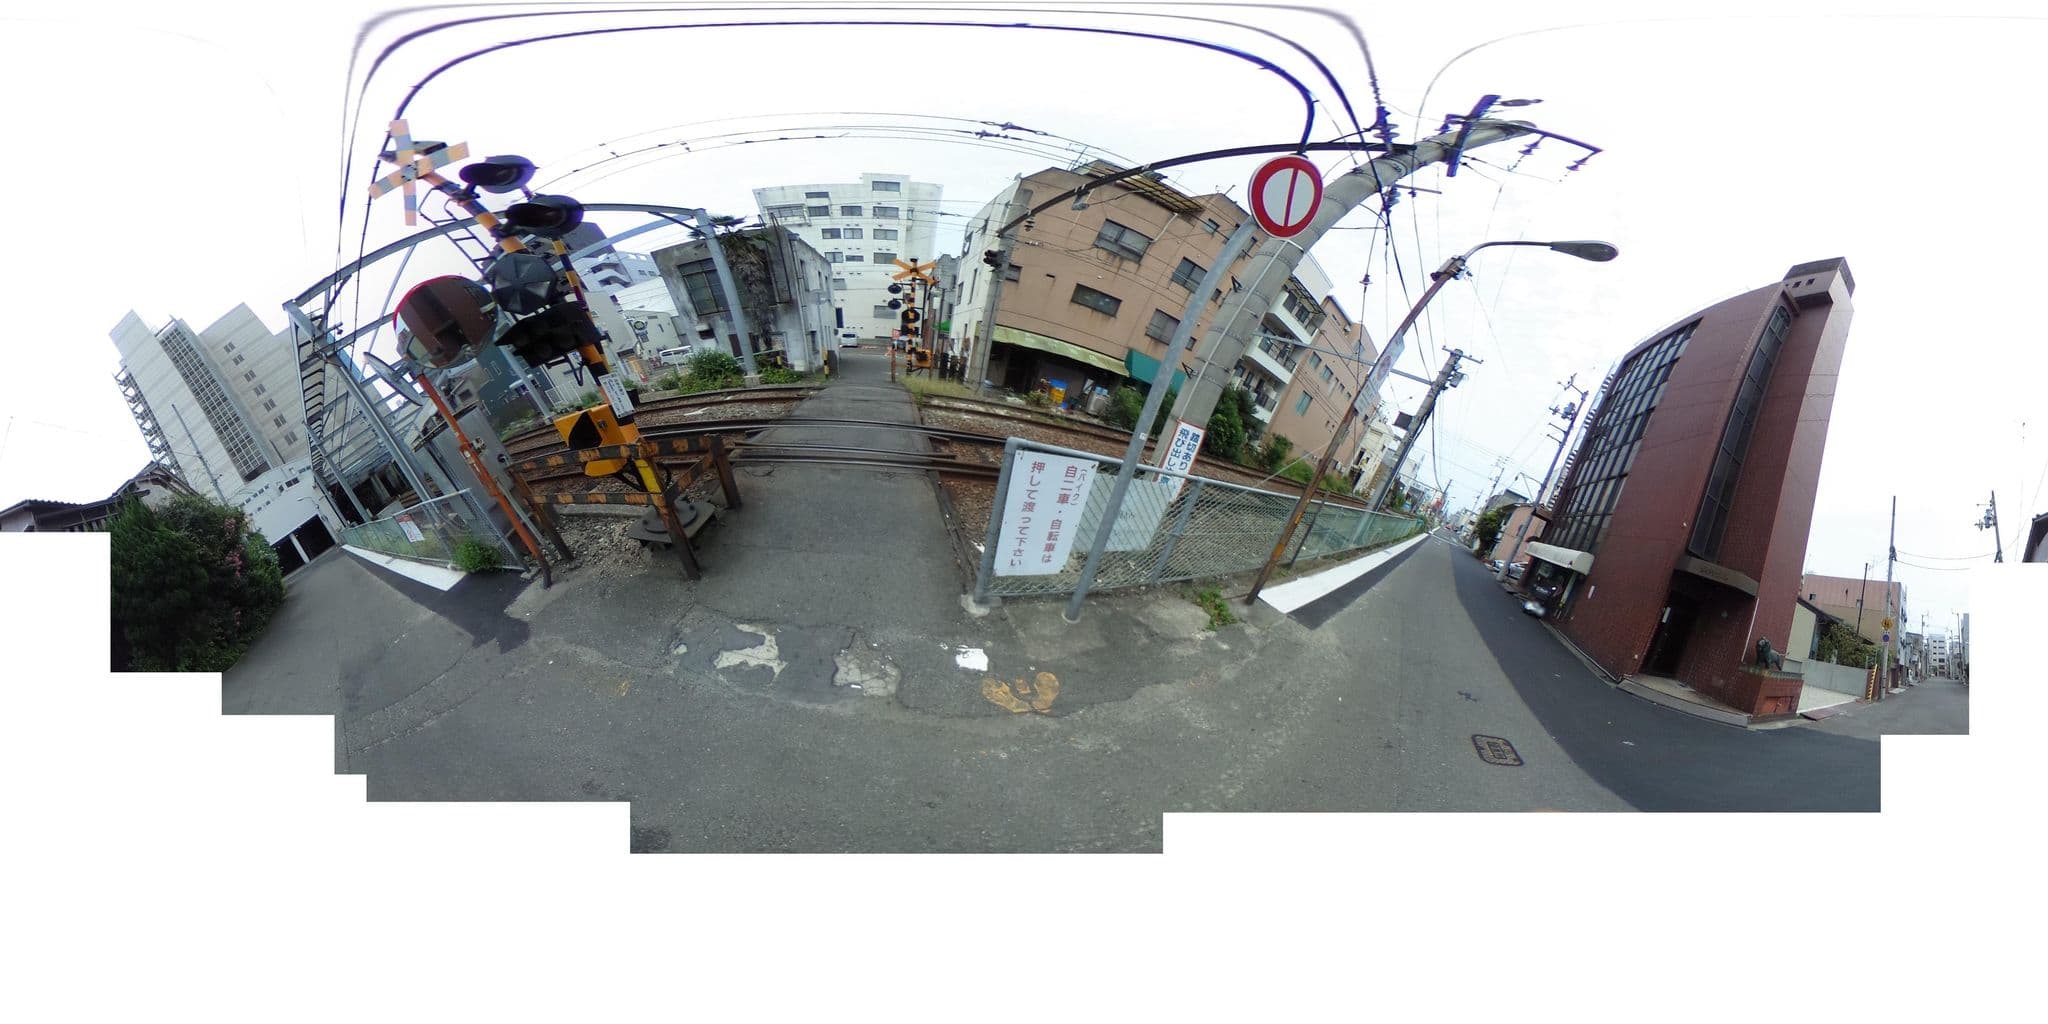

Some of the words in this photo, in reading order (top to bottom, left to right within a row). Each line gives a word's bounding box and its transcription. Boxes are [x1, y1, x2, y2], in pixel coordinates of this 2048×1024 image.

[1010, 461, 1046, 567] 押して渡って下さい
